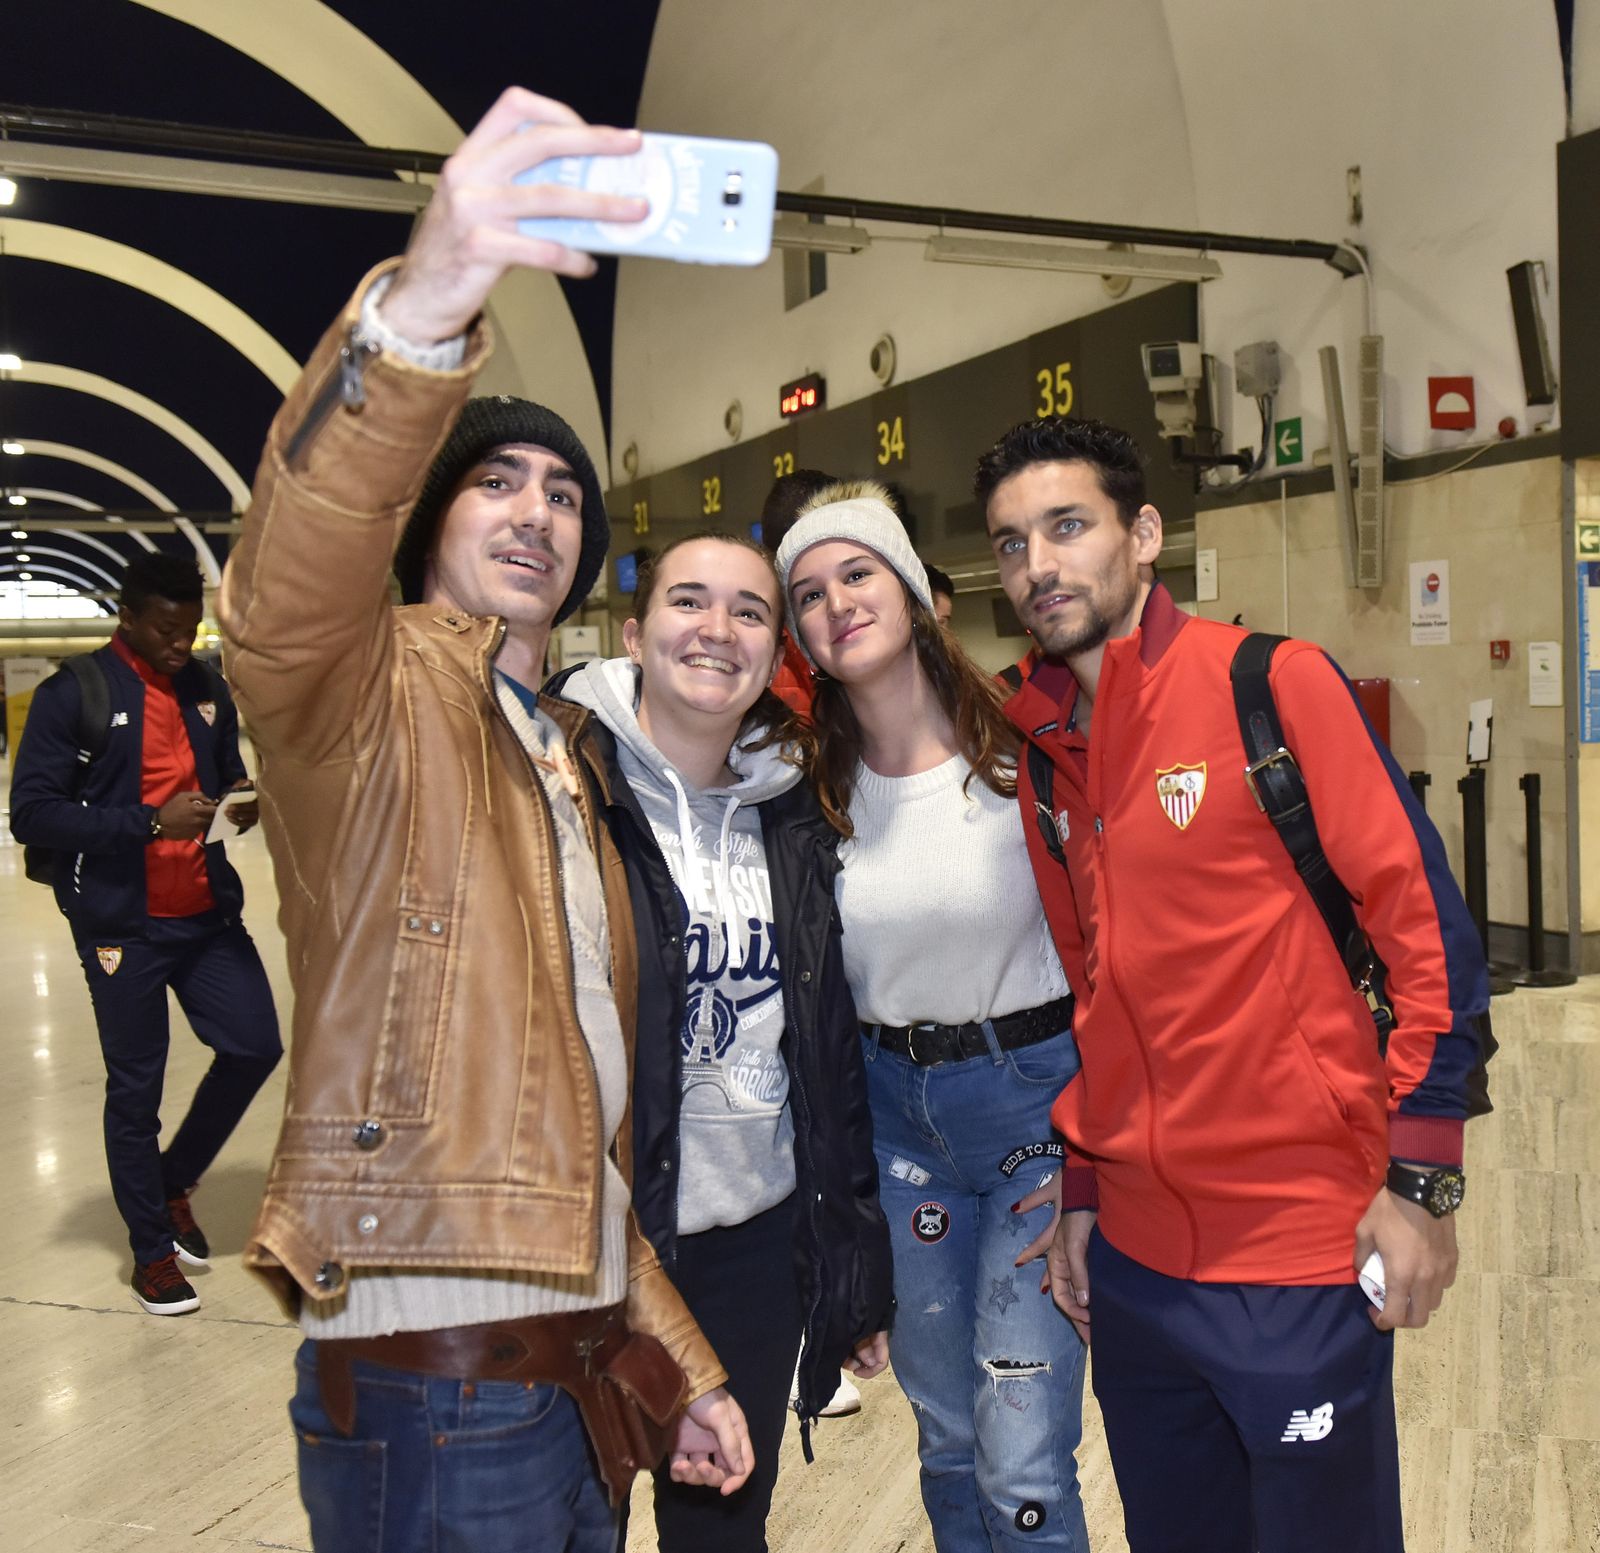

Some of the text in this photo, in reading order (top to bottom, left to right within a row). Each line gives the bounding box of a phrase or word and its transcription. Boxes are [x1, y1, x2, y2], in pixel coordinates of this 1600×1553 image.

[1036, 361, 1073, 418] 35
[877, 416, 905, 465] 34
[703, 476, 721, 514] 32
[633, 501, 648, 534] 31
[713, 831, 759, 864] Style
[1002, 1150, 1026, 1174] RIDE
[1026, 1143, 1044, 1156] TO
[1026, 1513, 1034, 1525] 8
